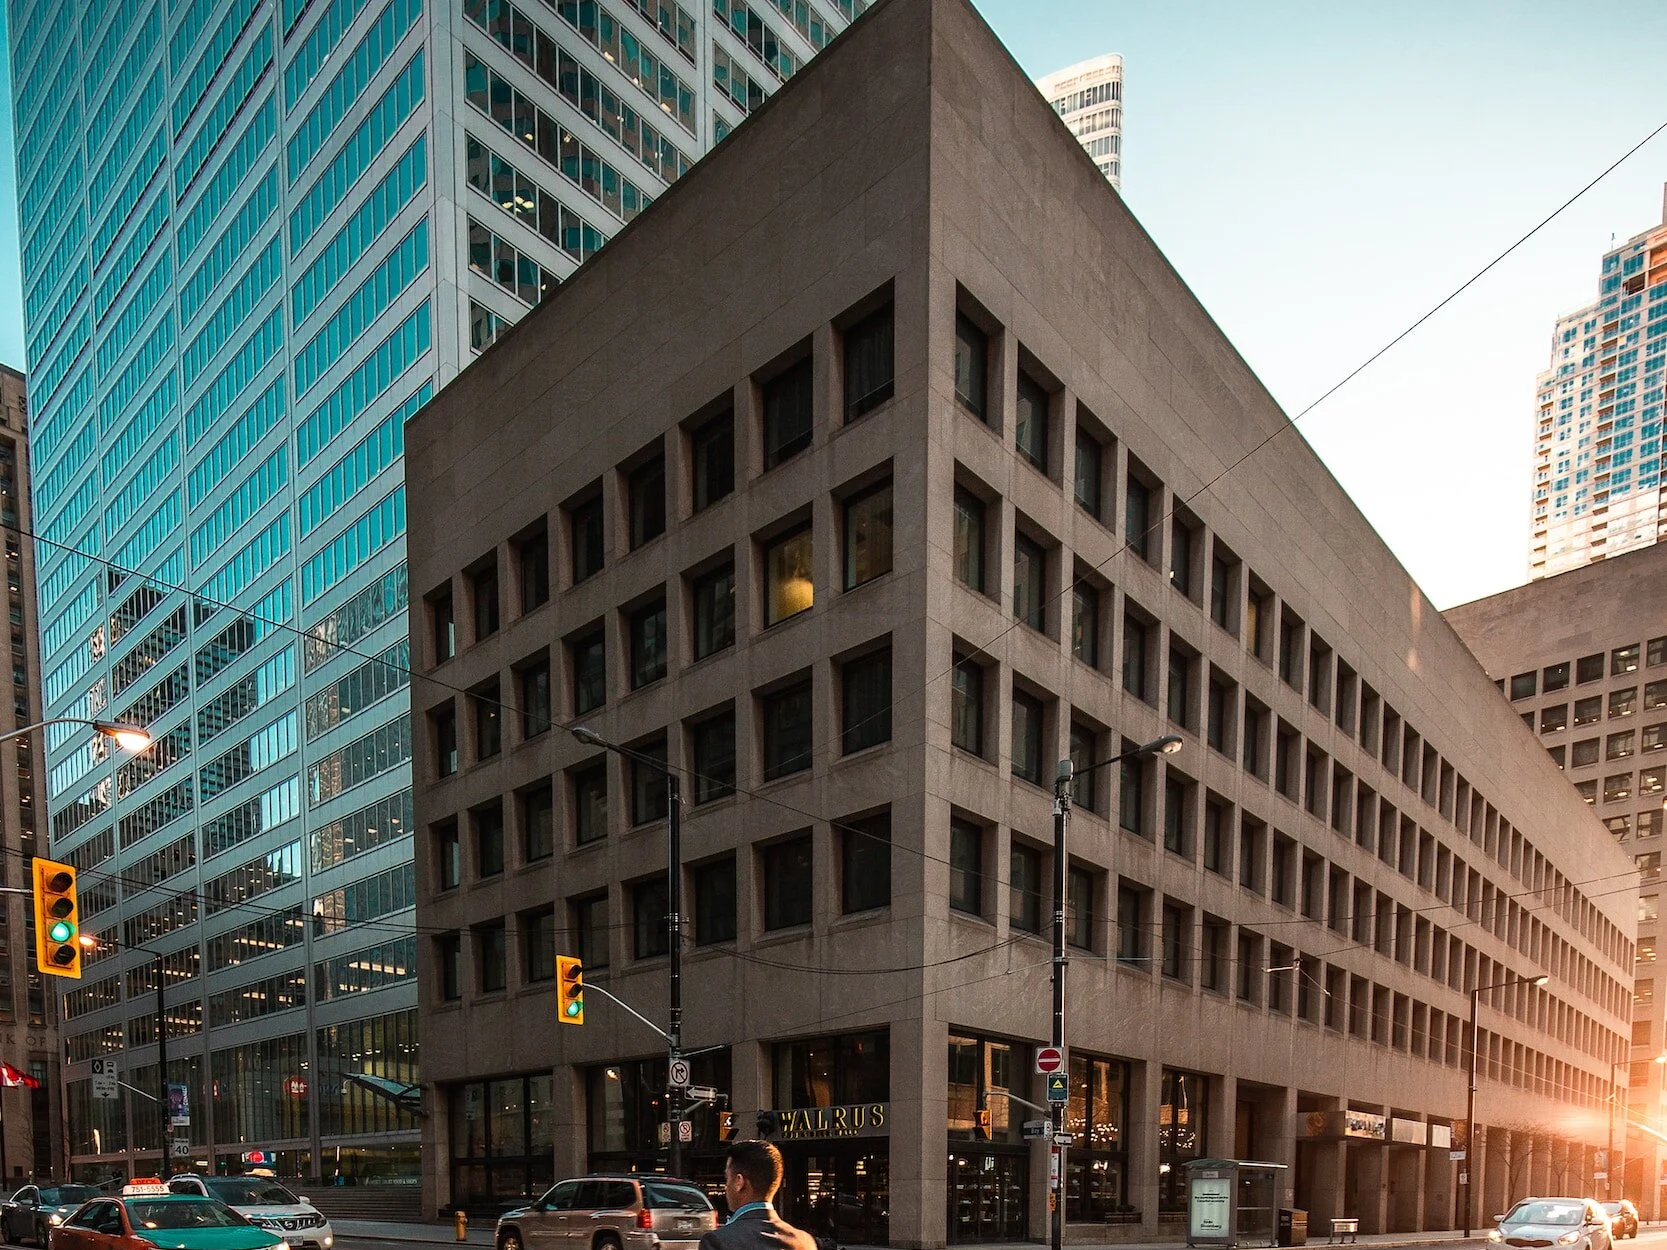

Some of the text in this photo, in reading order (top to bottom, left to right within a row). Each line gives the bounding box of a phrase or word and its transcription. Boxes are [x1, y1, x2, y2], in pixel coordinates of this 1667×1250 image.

[781, 1104, 884, 1131] WALRUS
[175, 1145, 189, 1155] 40
[131, 1185, 165, 1193] 751-5555
